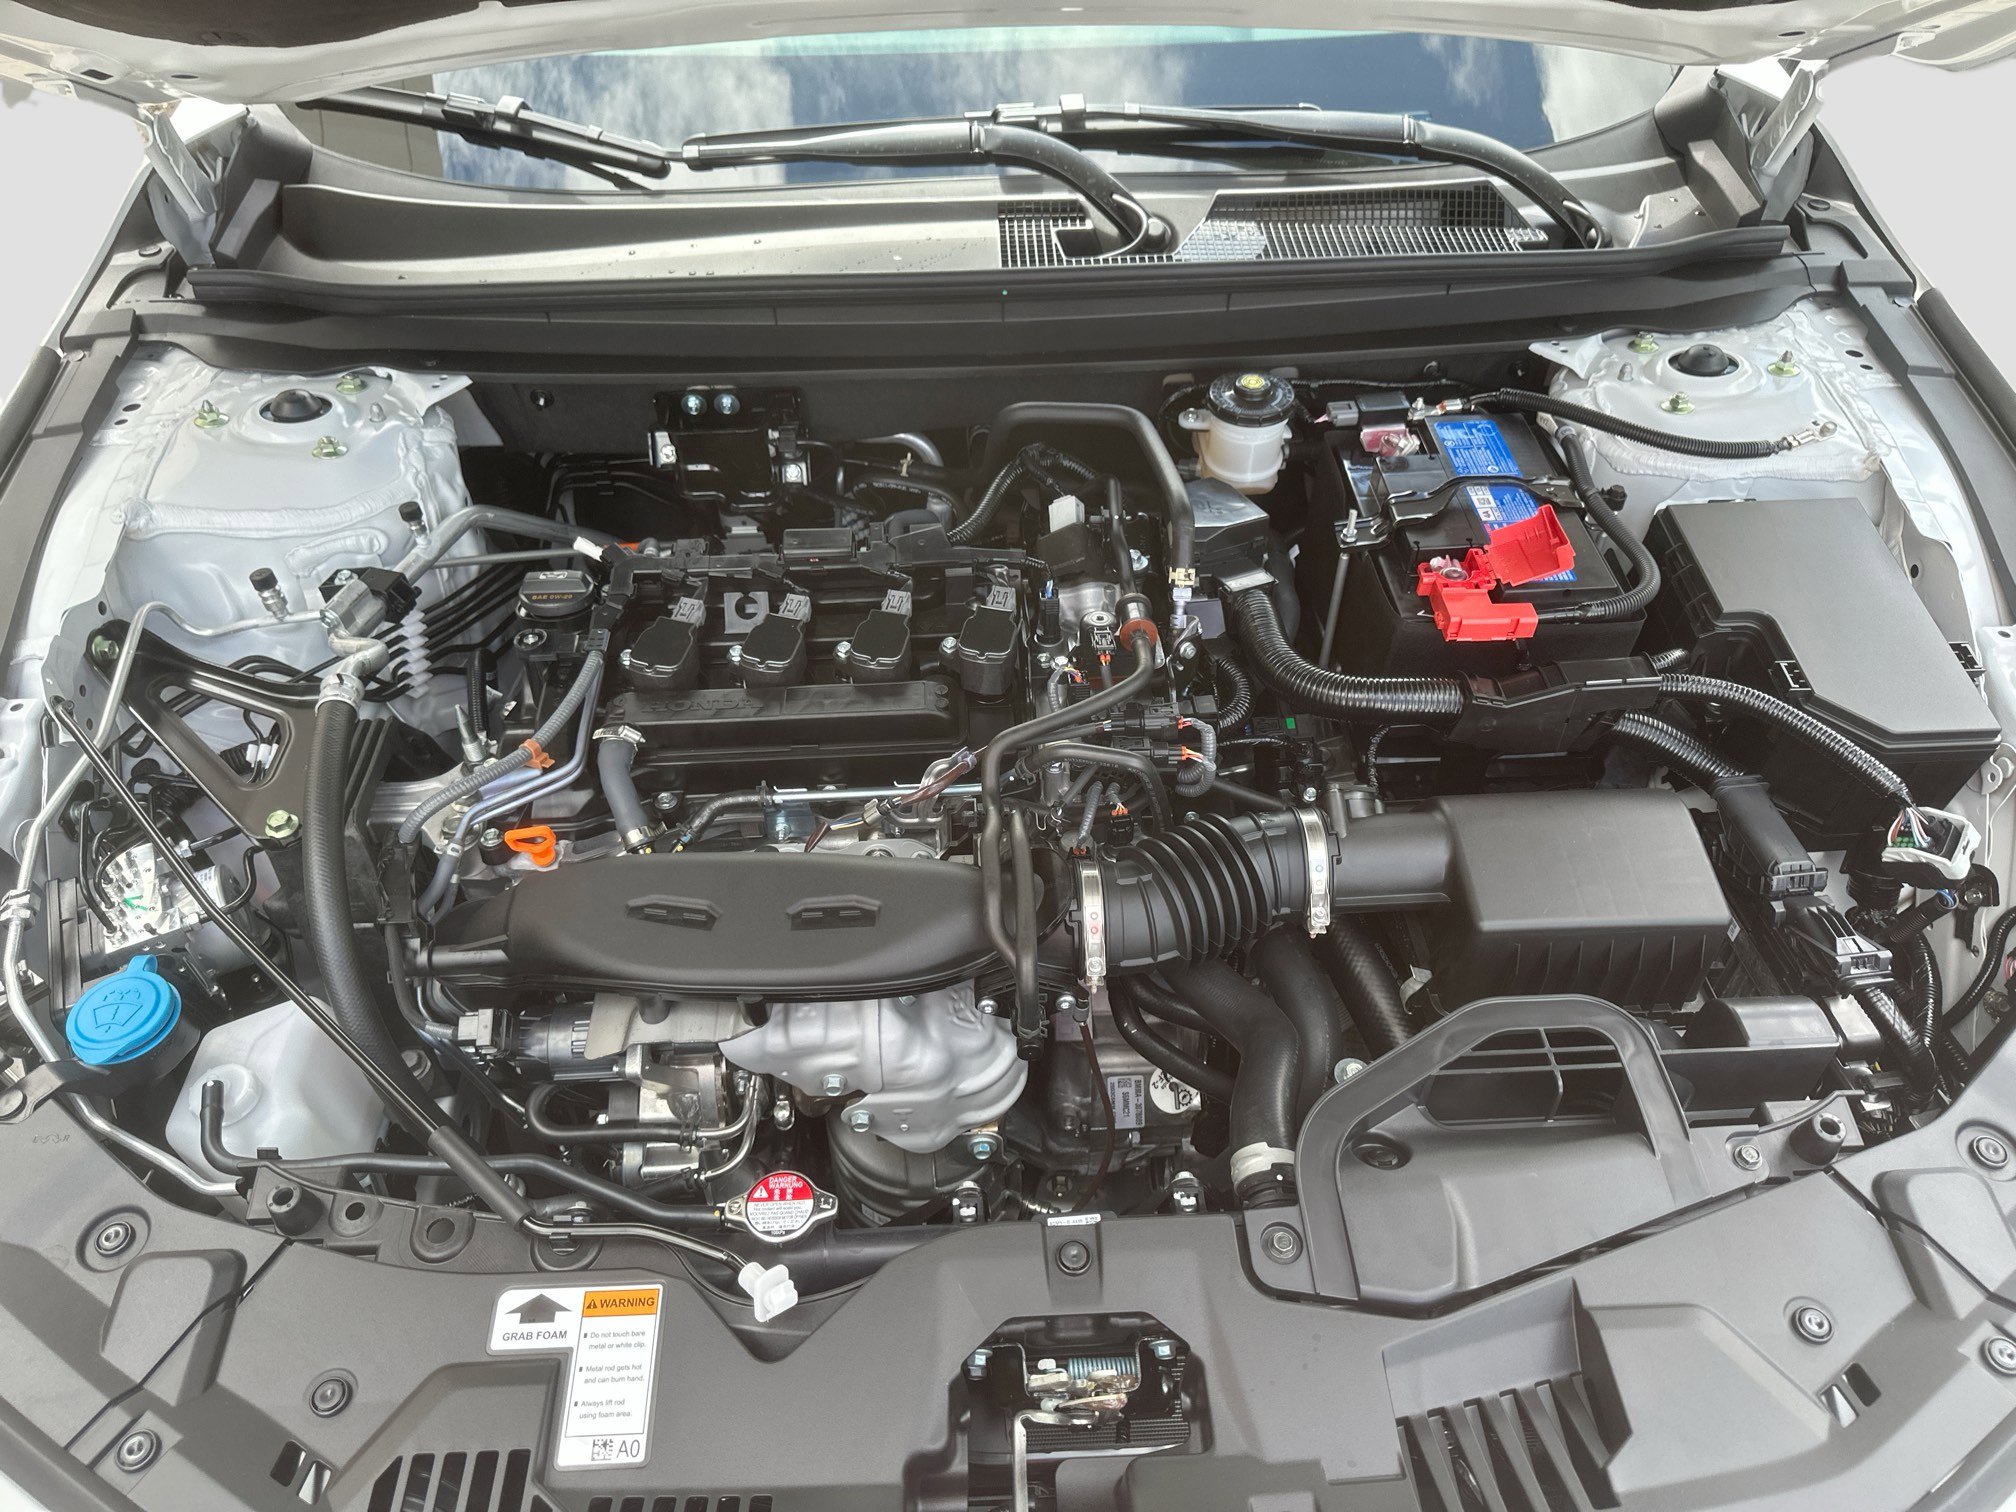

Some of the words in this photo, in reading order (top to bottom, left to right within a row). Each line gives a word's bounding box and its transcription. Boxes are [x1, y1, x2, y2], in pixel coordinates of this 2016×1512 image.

[640, 696, 765, 714] HONDA
[600, 1297, 655, 1309] WARNING
[502, 1332, 533, 1341] GRAB
[536, 1330, 567, 1340] FOAM
[590, 1331, 600, 1339] Do
[612, 1330, 630, 1338] touch
[589, 1342, 607, 1350] metal
[615, 1341, 632, 1349] white
[633, 1341, 647, 1350] clip.
[616, 1364, 631, 1373] gets
[584, 1376, 597, 1384] and
[580, 1400, 604, 1408] Always
[579, 1412, 597, 1420] using
